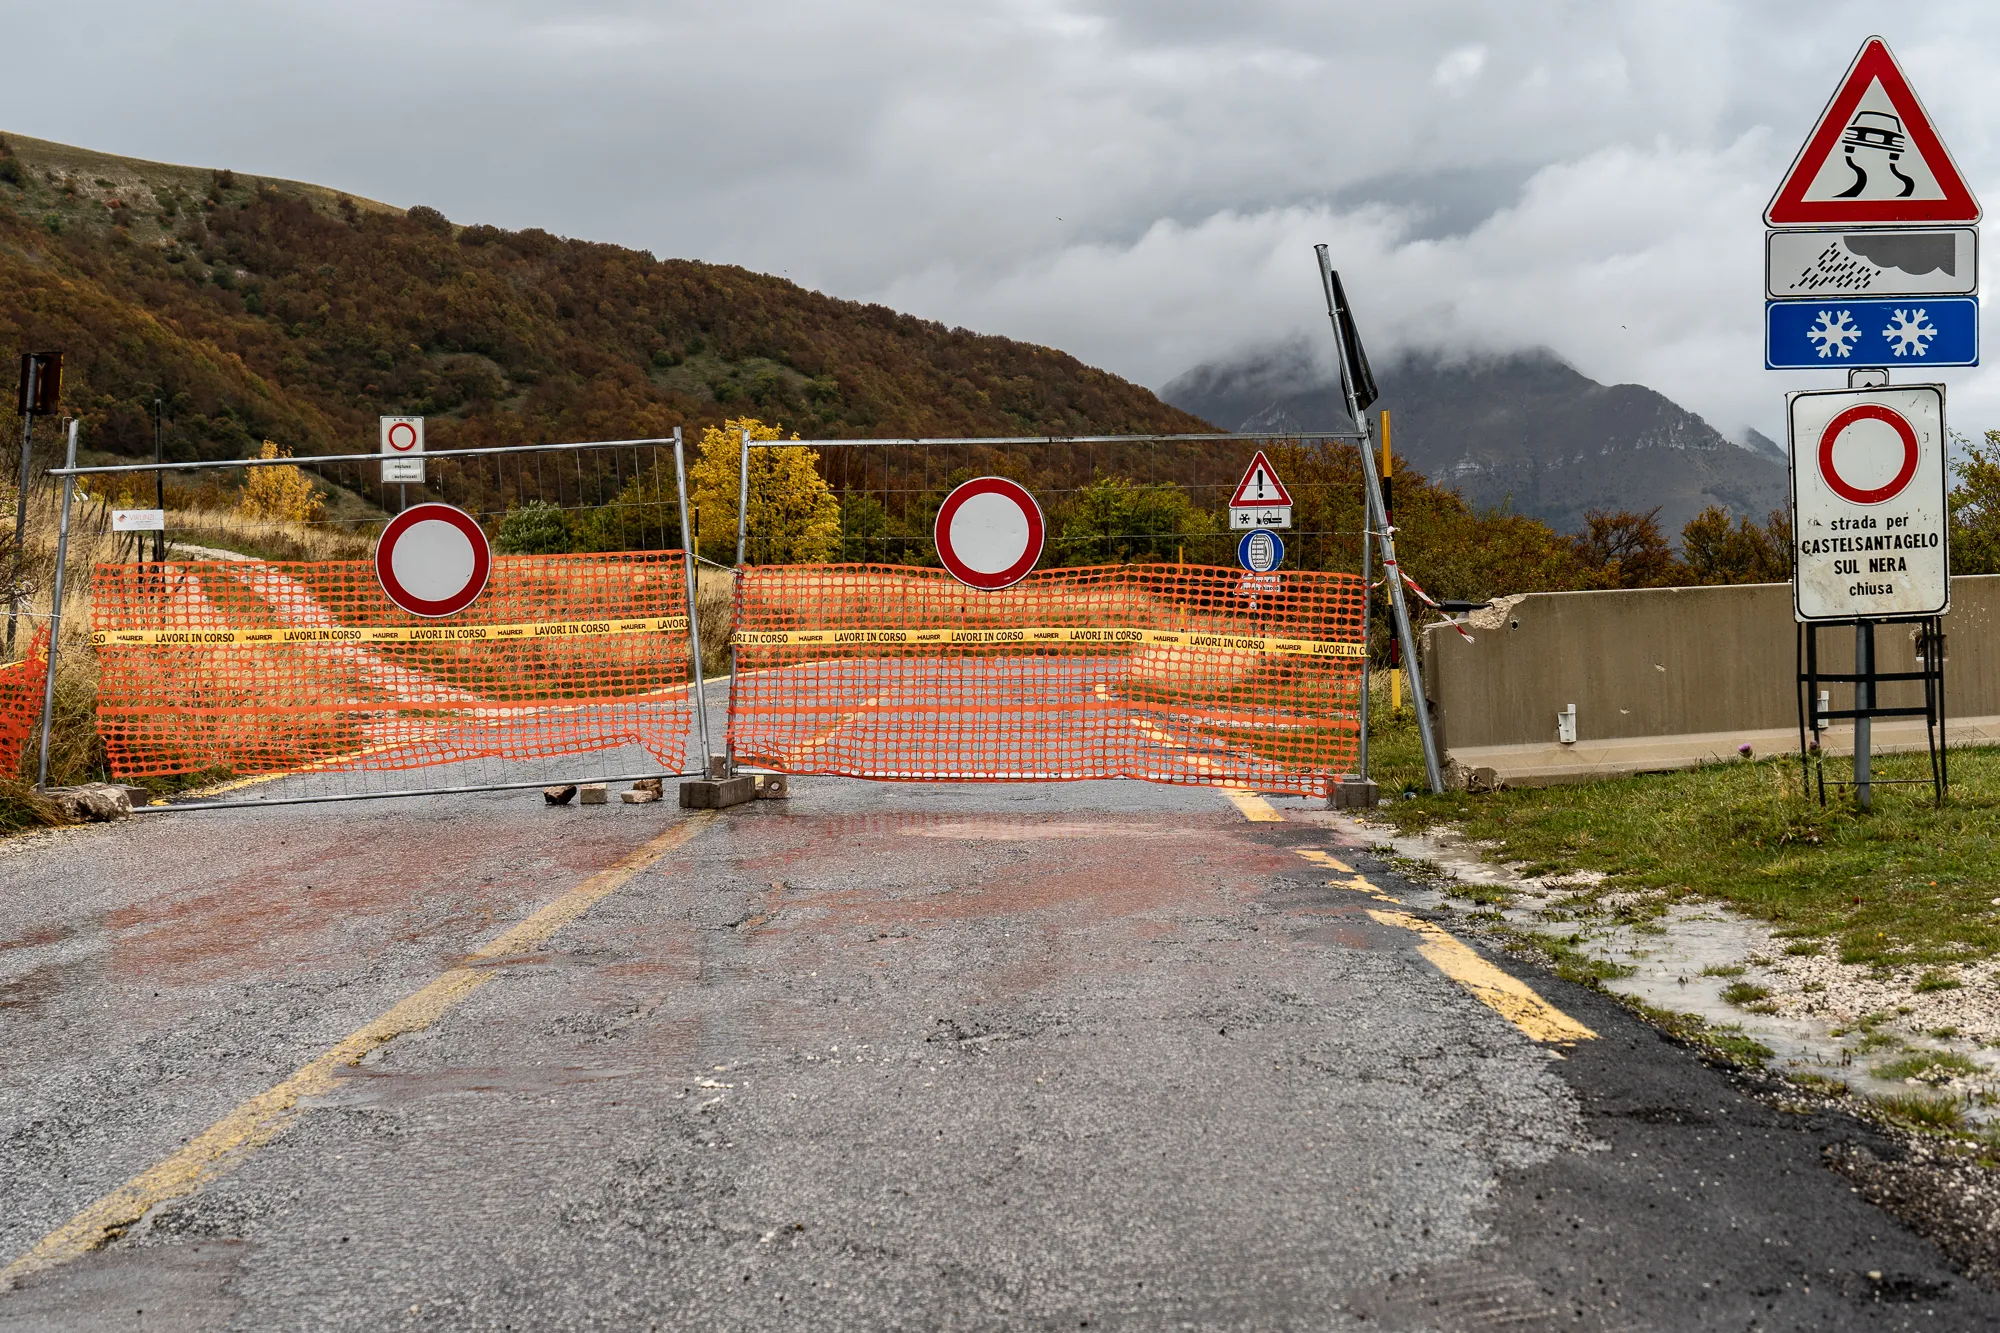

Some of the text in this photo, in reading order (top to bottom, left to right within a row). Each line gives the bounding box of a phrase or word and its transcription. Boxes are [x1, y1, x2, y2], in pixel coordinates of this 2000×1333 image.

[1831, 515, 1909, 530] strada per
[1801, 532, 1938, 554] CASTELSANTAGELO
[1834, 556, 1907, 575] SUL NERA
[1849, 582, 1894, 597] chiusa
[155, 633, 189, 643] LAVORI
[191, 633, 202, 643] IN
[204, 633, 235, 643] CORSO
[284, 630, 317, 641] LAVORI
[319, 630, 329, 640] IN
[331, 630, 362, 640] CORSO
[410, 629, 442, 640] LAVORI
[444, 629, 454, 639] IN
[456, 628, 487, 639] CORSO
[534, 625, 566, 636] LAVORI
[568, 624, 579, 634] IN
[580, 623, 610, 634] CORSO
[748, 633, 758, 643] IN
[760, 633, 788, 643] CORSO
[834, 632, 865, 642] LAVORI
[866, 632, 876, 642] IN
[878, 632, 907, 642] CORSO
[951, 632, 982, 642] LAVORI
[984, 632, 994, 642] IN
[996, 631, 1024, 641] CORSO
[1070, 630, 1101, 641] LAVORI
[1103, 630, 1114, 640] IN
[1116, 631, 1143, 641] CORSO
[1153, 635, 1179, 643] MAURER
[1190, 635, 1221, 647] LAVORI
[1223, 638, 1234, 648] IN
[1236, 639, 1265, 650] CORSO
[1276, 643, 1302, 651] MAURER
[1313, 643, 1344, 655] LAVORI
[1346, 645, 1357, 655] IN
[1359, 646, 1368, 656] C
